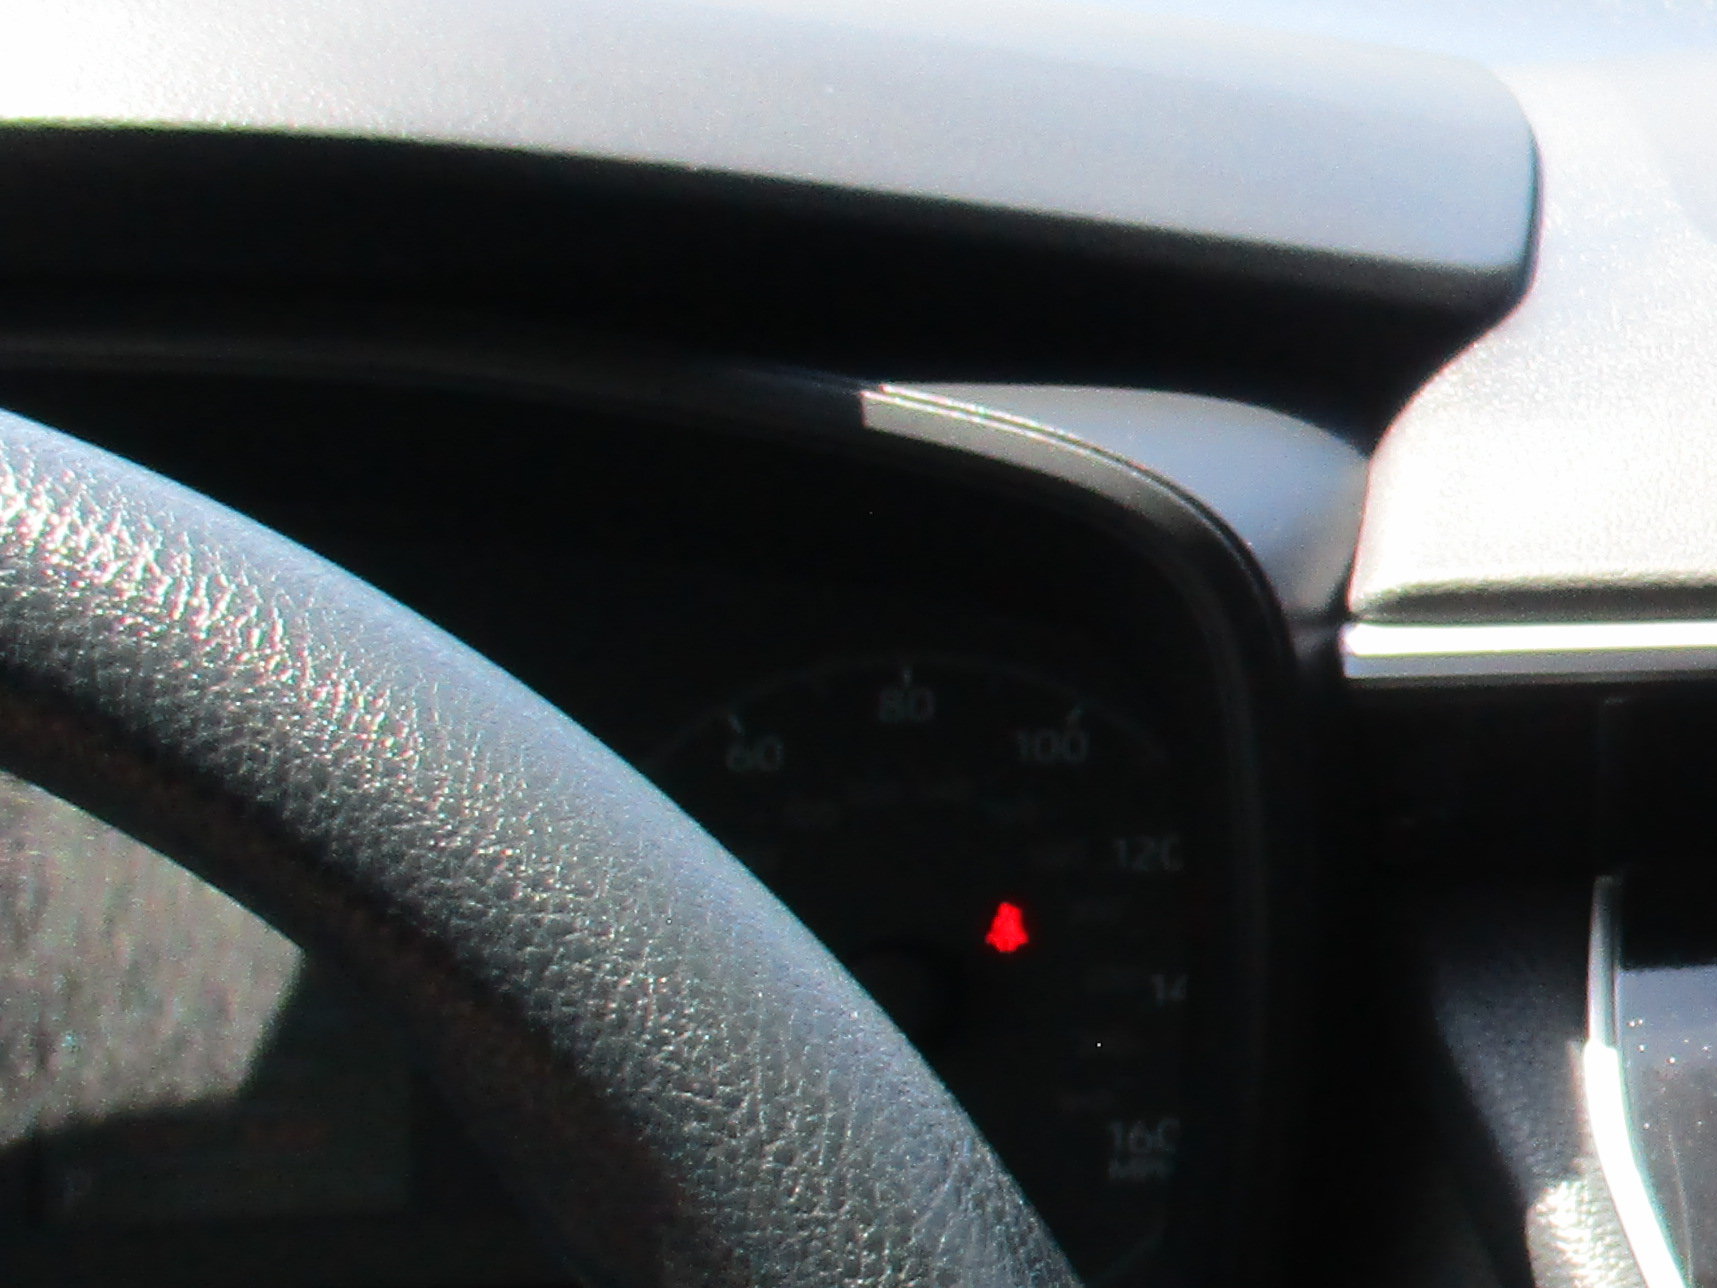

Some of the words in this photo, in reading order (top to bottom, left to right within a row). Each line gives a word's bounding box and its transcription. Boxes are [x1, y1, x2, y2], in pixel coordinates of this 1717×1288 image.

[880, 685, 934, 720] 80
[726, 738, 783, 771] 60
[1017, 729, 1088, 761] 100
